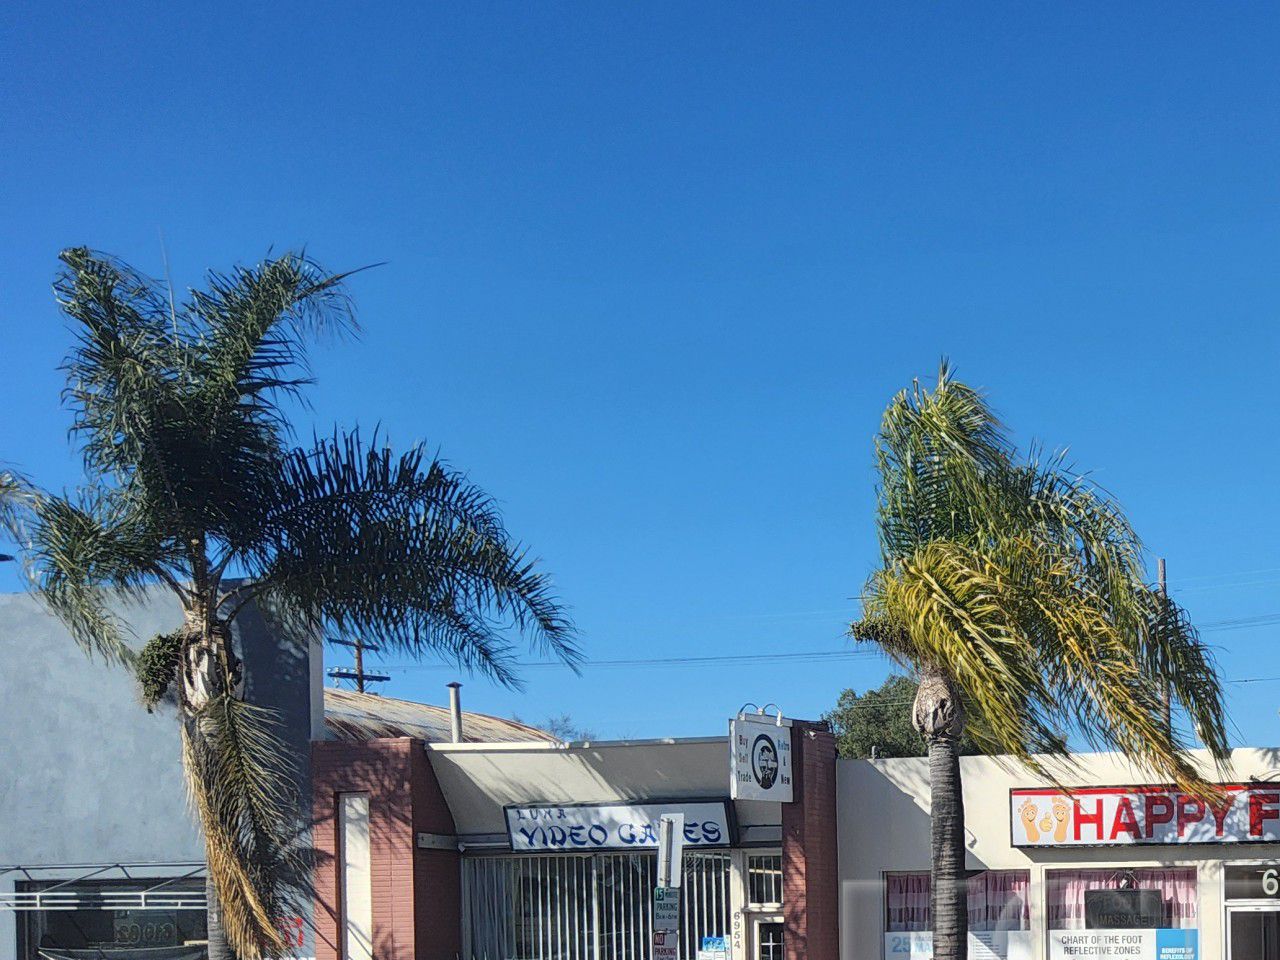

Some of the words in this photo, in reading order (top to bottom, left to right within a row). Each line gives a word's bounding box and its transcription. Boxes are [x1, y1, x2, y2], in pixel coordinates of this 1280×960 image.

[738, 770, 752, 783] Trade
[1073, 794, 1239, 840] HAPPY
[519, 823, 608, 848] VIDEO
[617, 820, 722, 845] GAES
[656, 887, 665, 900] 15
[656, 902, 678, 912] PARKING
[733, 911, 741, 949] 6954
[654, 933, 665, 945] NO
[1061, 935, 1089, 945] CHART
[1091, 935, 1102, 945] OF
[1104, 935, 1120, 945] THE
[1121, 934, 1143, 945] FOOT
[655, 947, 677, 956] PARKING
[1063, 946, 1113, 955] REFLECTIVE
[1113, 946, 1141, 955] ZONES
